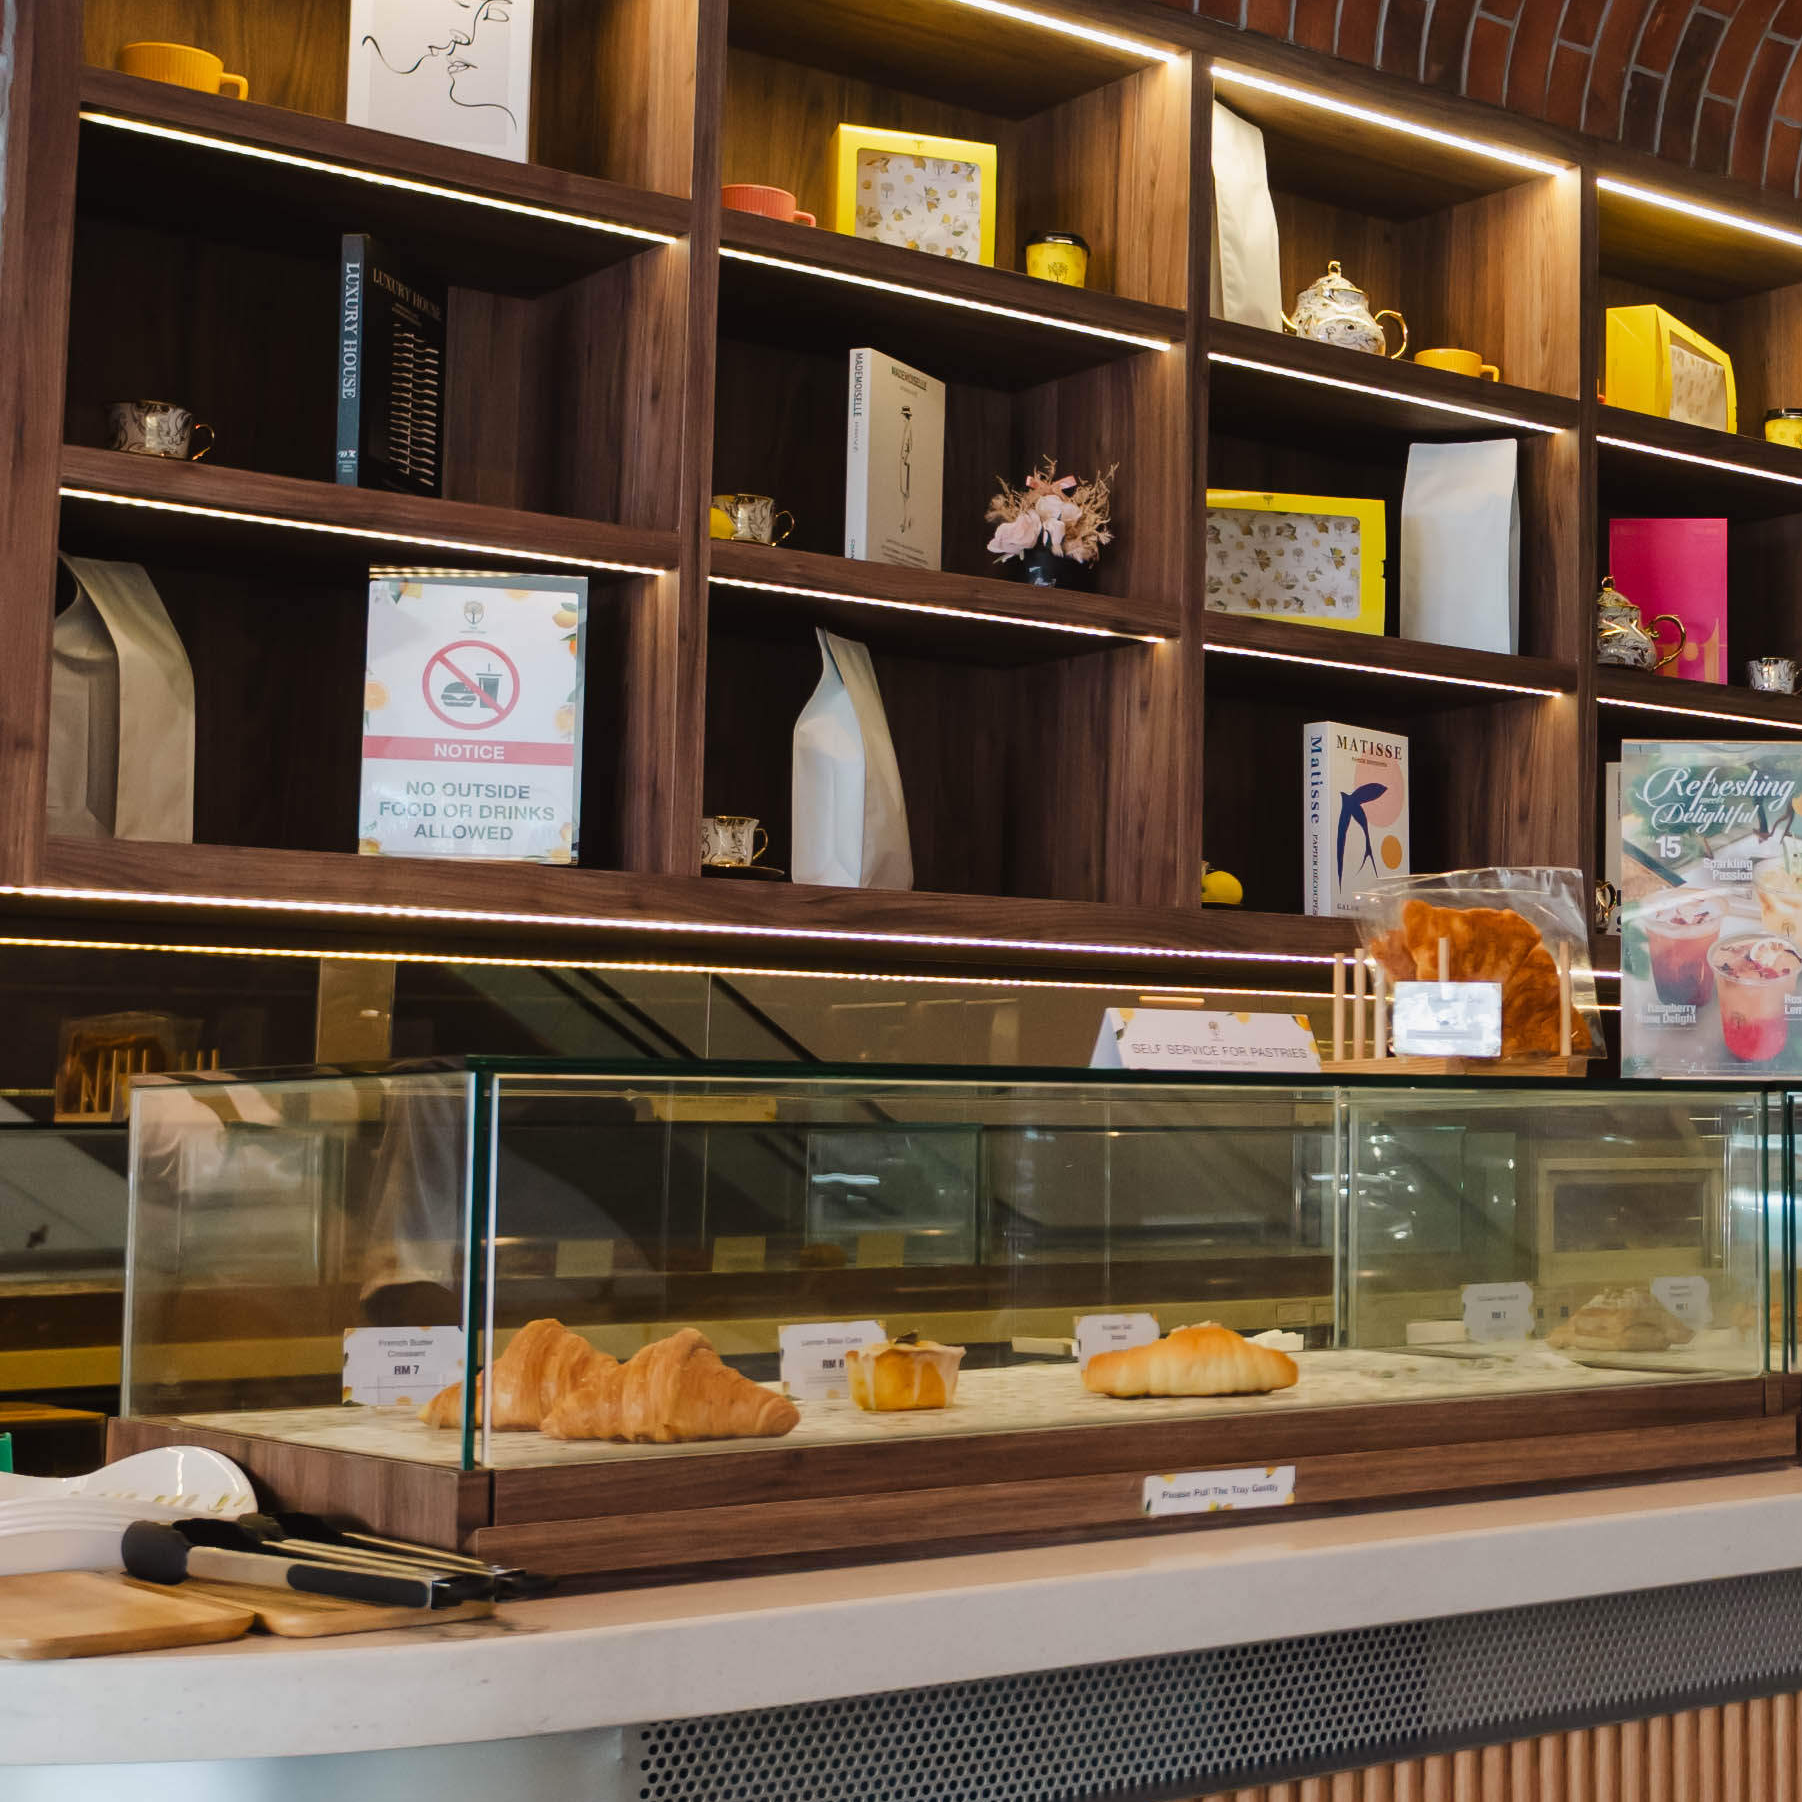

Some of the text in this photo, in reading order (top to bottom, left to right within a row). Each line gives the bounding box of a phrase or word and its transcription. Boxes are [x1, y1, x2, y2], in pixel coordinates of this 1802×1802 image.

[373, 267, 412, 302] LUXURY
[342, 262, 360, 399] LUXURY HOUSE
[853, 352, 864, 418] MADEMOISELLE
[433, 743, 505, 761] NOTICE
[1336, 734, 1403, 760] MATISSE
[1310, 734, 1323, 824] Matisse
[406, 781, 531, 800] NO OUTSIDE
[1636, 766, 1796, 812] Refreshing
[379, 801, 555, 821] FOOD OR DRINKS
[1651, 803, 1760, 834] Delightful
[413, 823, 514, 841] ALLOWED
[1655, 835, 1682, 859] 15
[1703, 857, 1753, 874] Sparkling
[1712, 869, 1753, 881] Passion
[1663, 1013, 1697, 1026] Delight
[1131, 1043, 1308, 1059] SELF SERVICE FOR PASTRIES
[394, 1365, 420, 1375] RM 7
[822, 1359, 837, 1369] RM
[1162, 1490, 1191, 1499] Please
[1213, 1486, 1228, 1495] The
[1231, 1485, 1249, 1495] Tray
